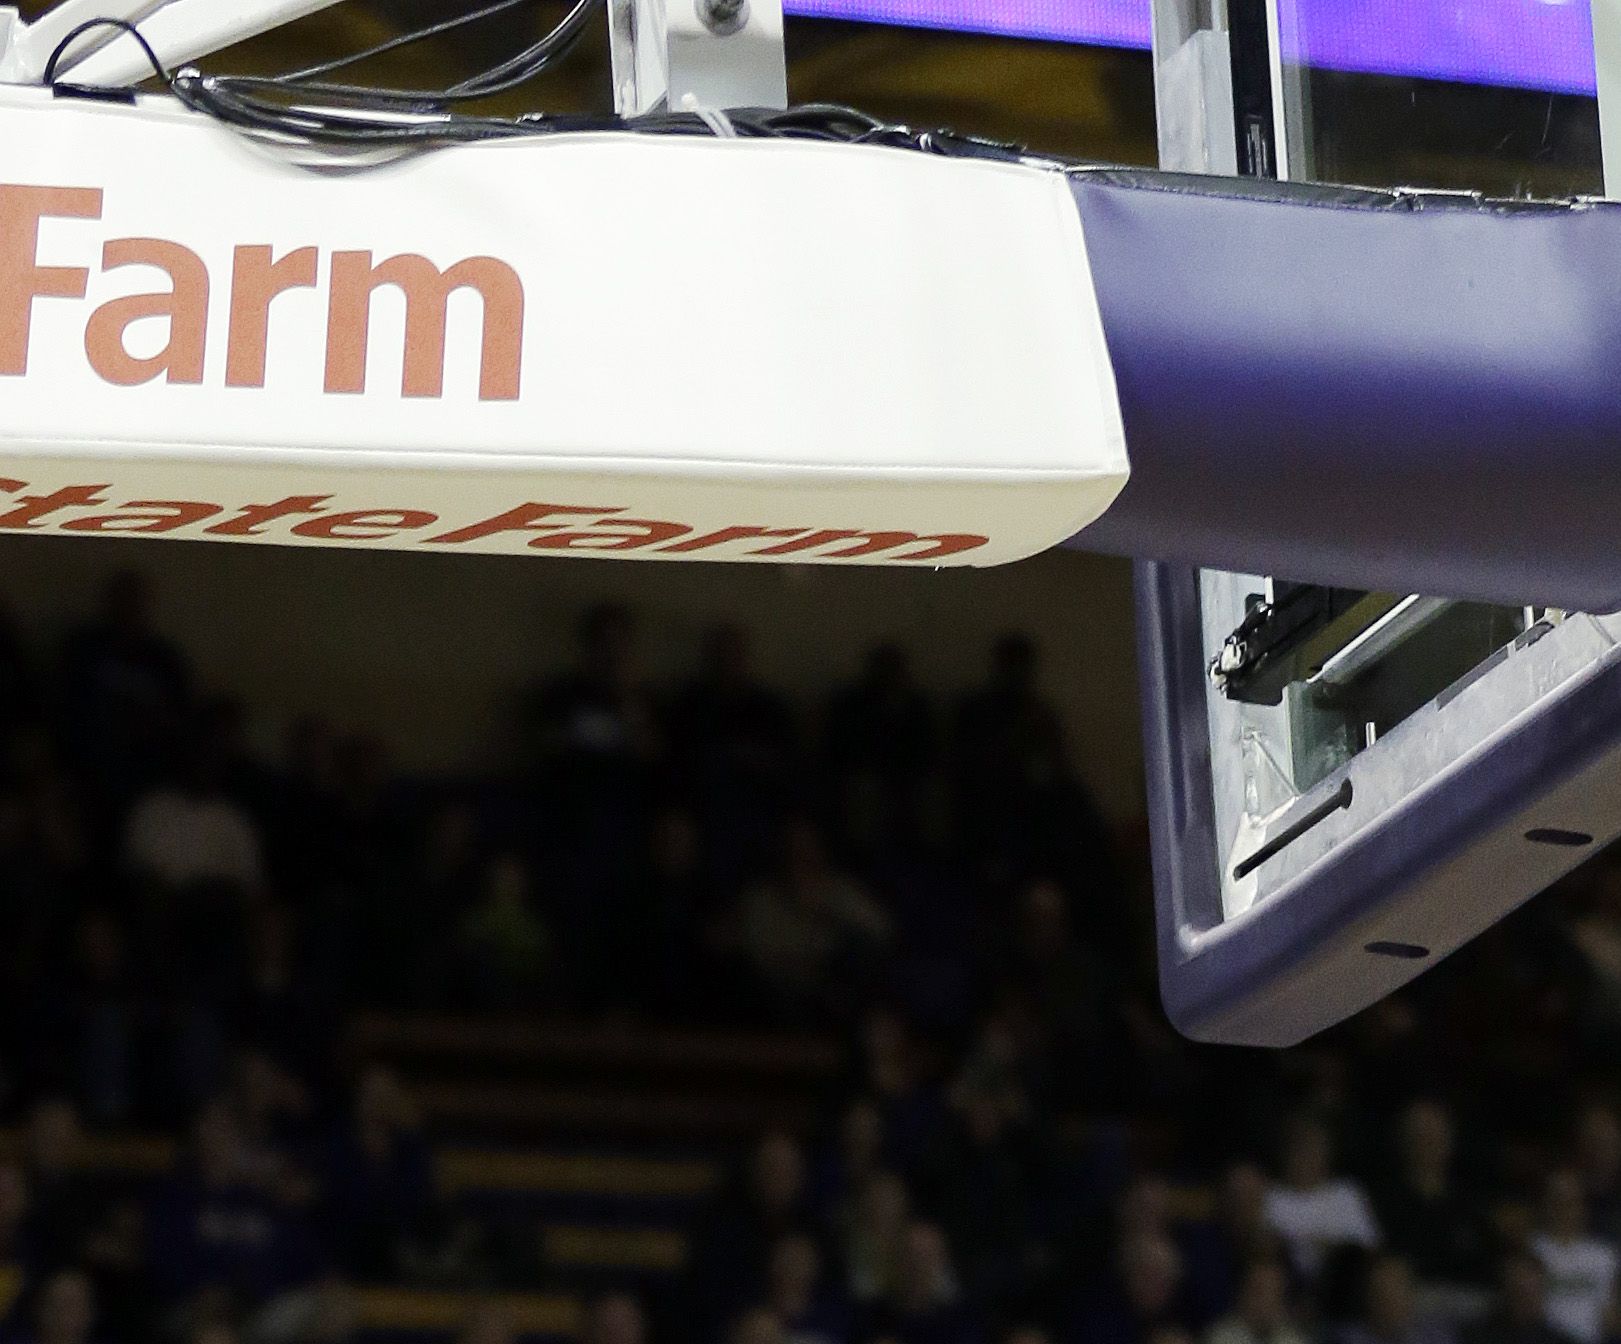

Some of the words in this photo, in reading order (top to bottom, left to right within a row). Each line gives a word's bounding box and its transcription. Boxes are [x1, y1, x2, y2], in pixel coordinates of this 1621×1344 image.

[0, 186, 524, 401] Farm
[0, 477, 439, 541] tate
[418, 501, 991, 562] Farm
